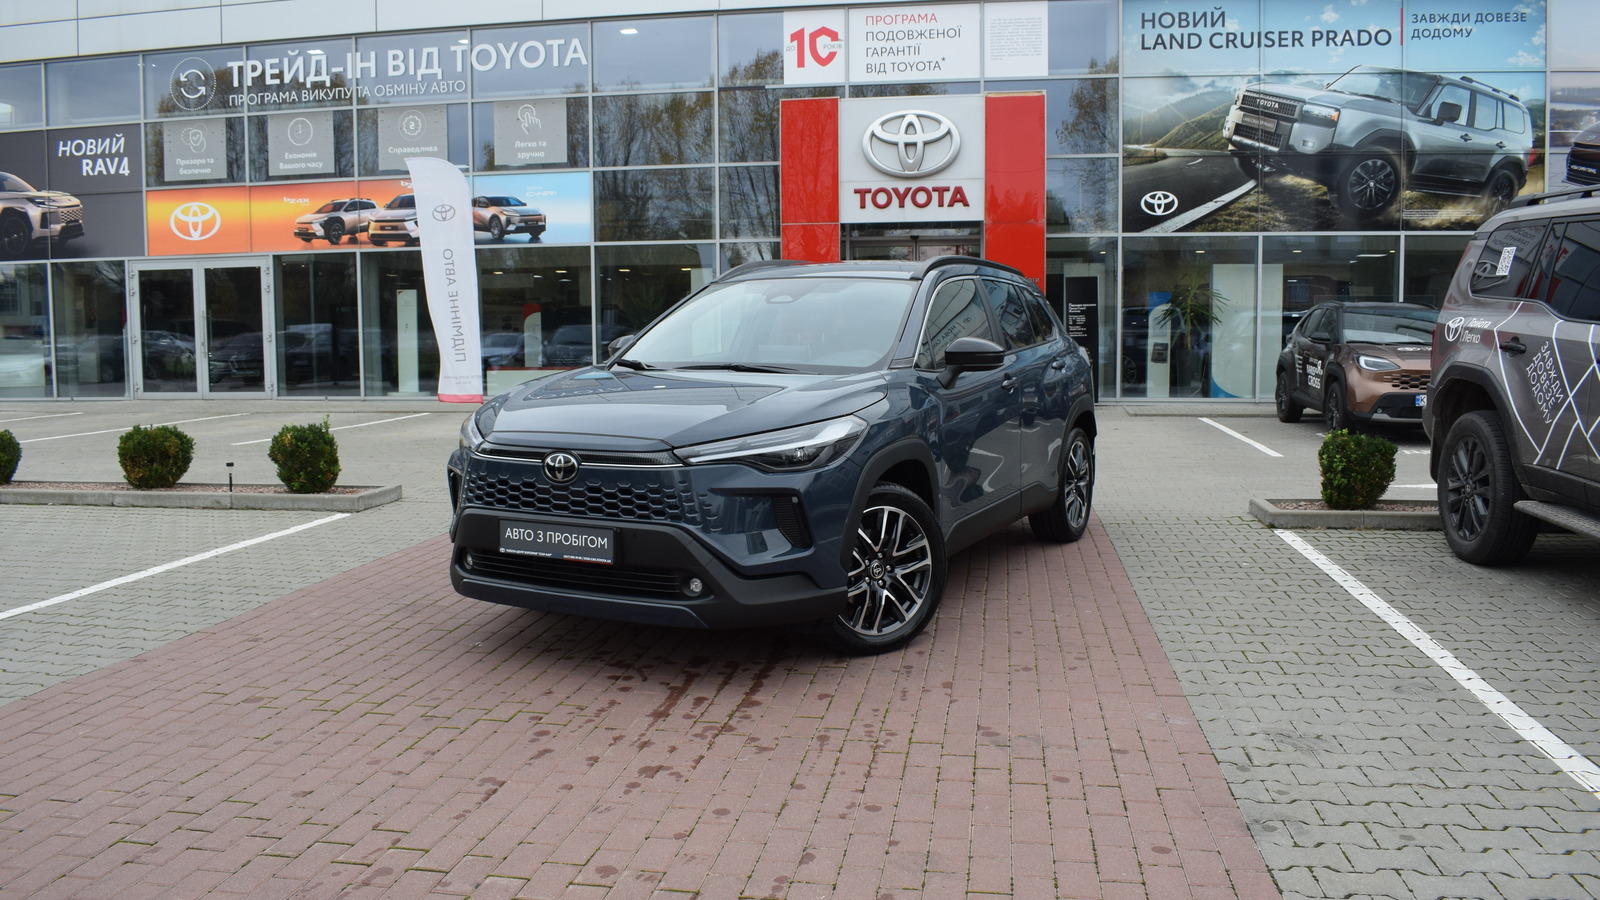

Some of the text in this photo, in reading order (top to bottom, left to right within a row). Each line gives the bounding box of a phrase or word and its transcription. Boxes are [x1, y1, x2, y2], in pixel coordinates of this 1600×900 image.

[865, 13, 937, 26] ПРОГРАМА
[1141, 6, 1226, 29] НОВИЙ
[1411, 12, 1527, 25] ЗАВЖДИ ДОВЕЗЕ
[865, 26, 962, 43] ПОДОВЖЕНОЇ
[1141, 28, 1393, 50] LAND CRUISER PRADO
[1411, 28, 1473, 40] ДОДОМУ
[865, 43, 922, 58] ГАРАНТІЇ
[227, 38, 588, 88] ТРЕЙД-ІН ВІД TOYOTA
[865, 62, 887, 75] ВІД
[229, 80, 466, 107] ПРОГРАМА ВИКУПУ ТА ОБМІНУ АВТО
[1256, 98, 1279, 109] TOYOTA
[58, 133, 125, 158] НОВИЙ
[388, 146, 438, 155] Справедлива
[514, 140, 537, 148] Легко
[284, 151, 318, 160] Економія
[517, 151, 545, 159] зручно
[81, 156, 131, 176] RAV4
[175, 158, 206, 168] Прозоро
[279, 161, 324, 170] Вашого часу
[178, 167, 212, 175] безпечно
[853, 186, 970, 210] TOYOTA
[1462, 330, 1481, 344] Легко
[1541, 341, 1564, 404] ЗАВЖДИ
[1532, 352, 1556, 409] ДОВЕЗЕ
[1526, 363, 1553, 424] ДОДОМУ
[505, 527, 608, 550] АВТО З ПРОБІГОМ
